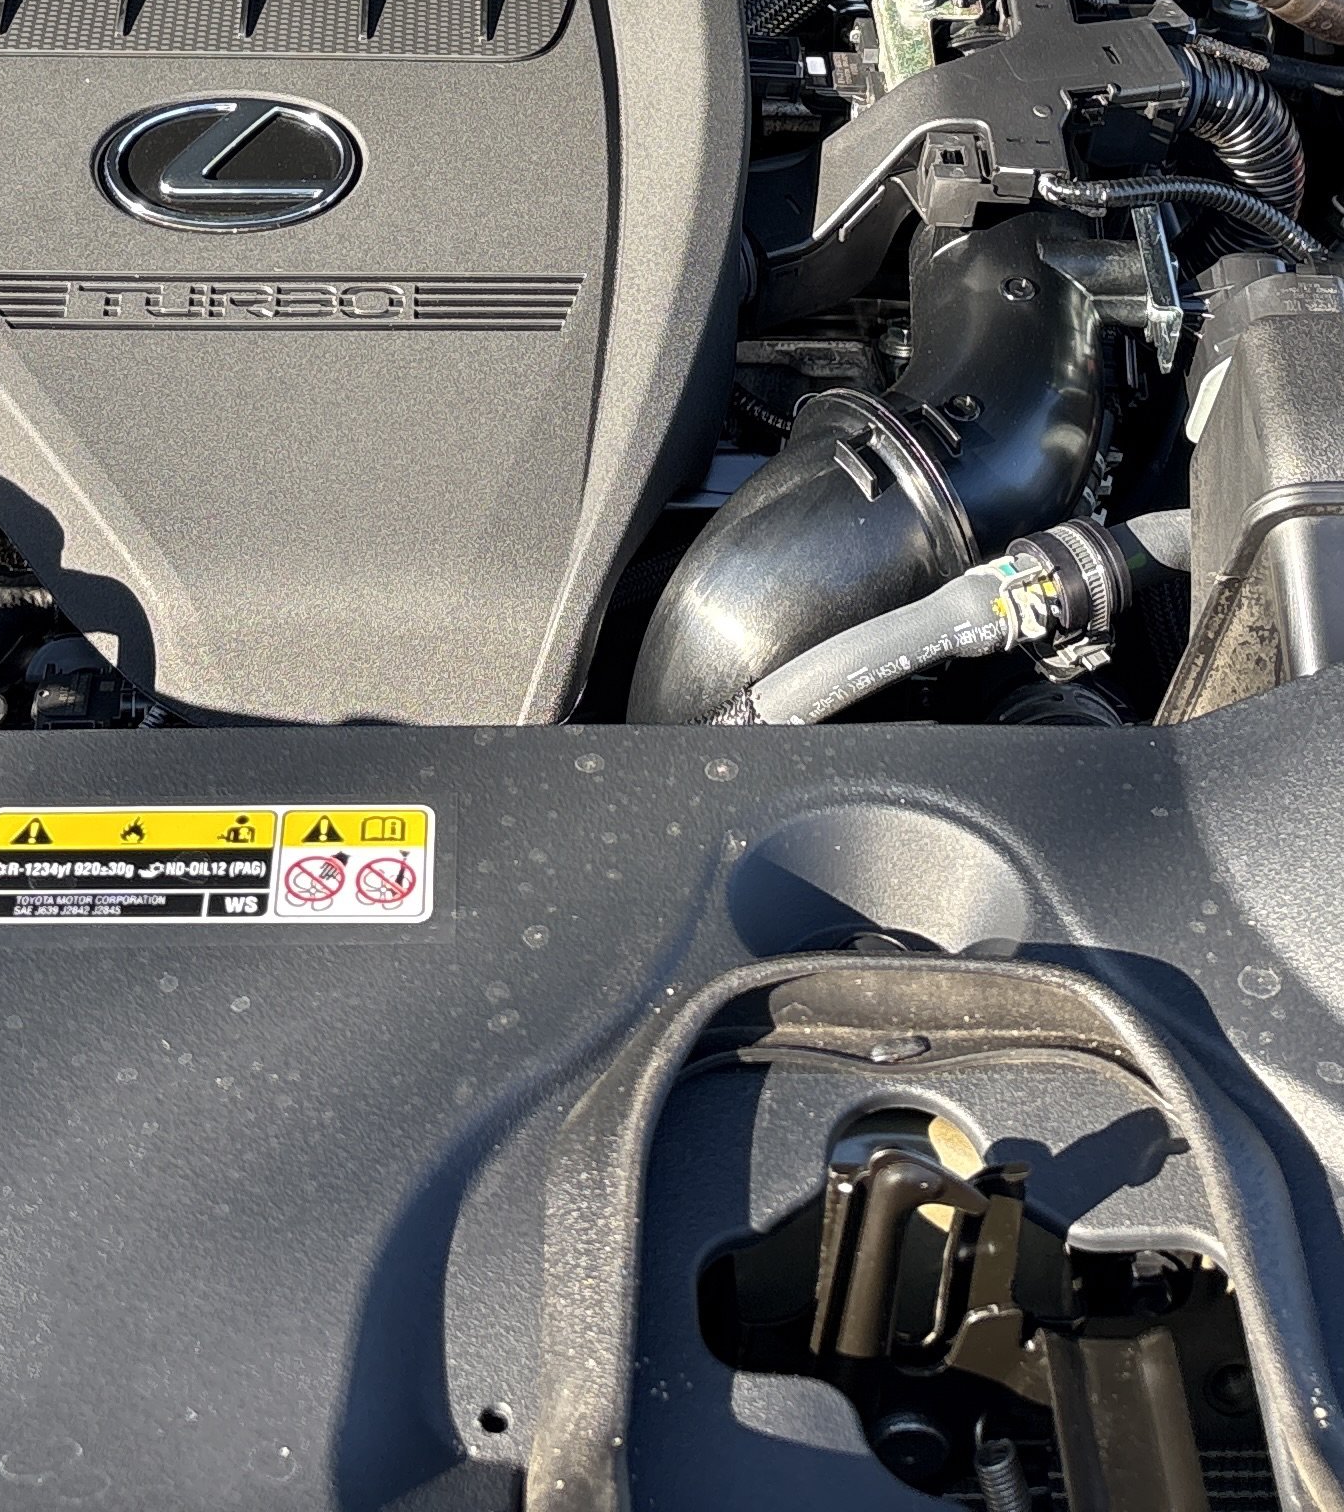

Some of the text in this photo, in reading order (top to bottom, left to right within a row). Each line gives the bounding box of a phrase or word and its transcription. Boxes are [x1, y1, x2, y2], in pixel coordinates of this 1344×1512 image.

[78, 283, 408, 319] TURBO
[7, 862, 72, 878] R-1234yf
[229, 861, 267, 878] (PAG)
[16, 894, 167, 905] TOYOTA MOTOR CORPORATION
[224, 895, 259, 914] WS
[13, 906, 35, 917] SAE
